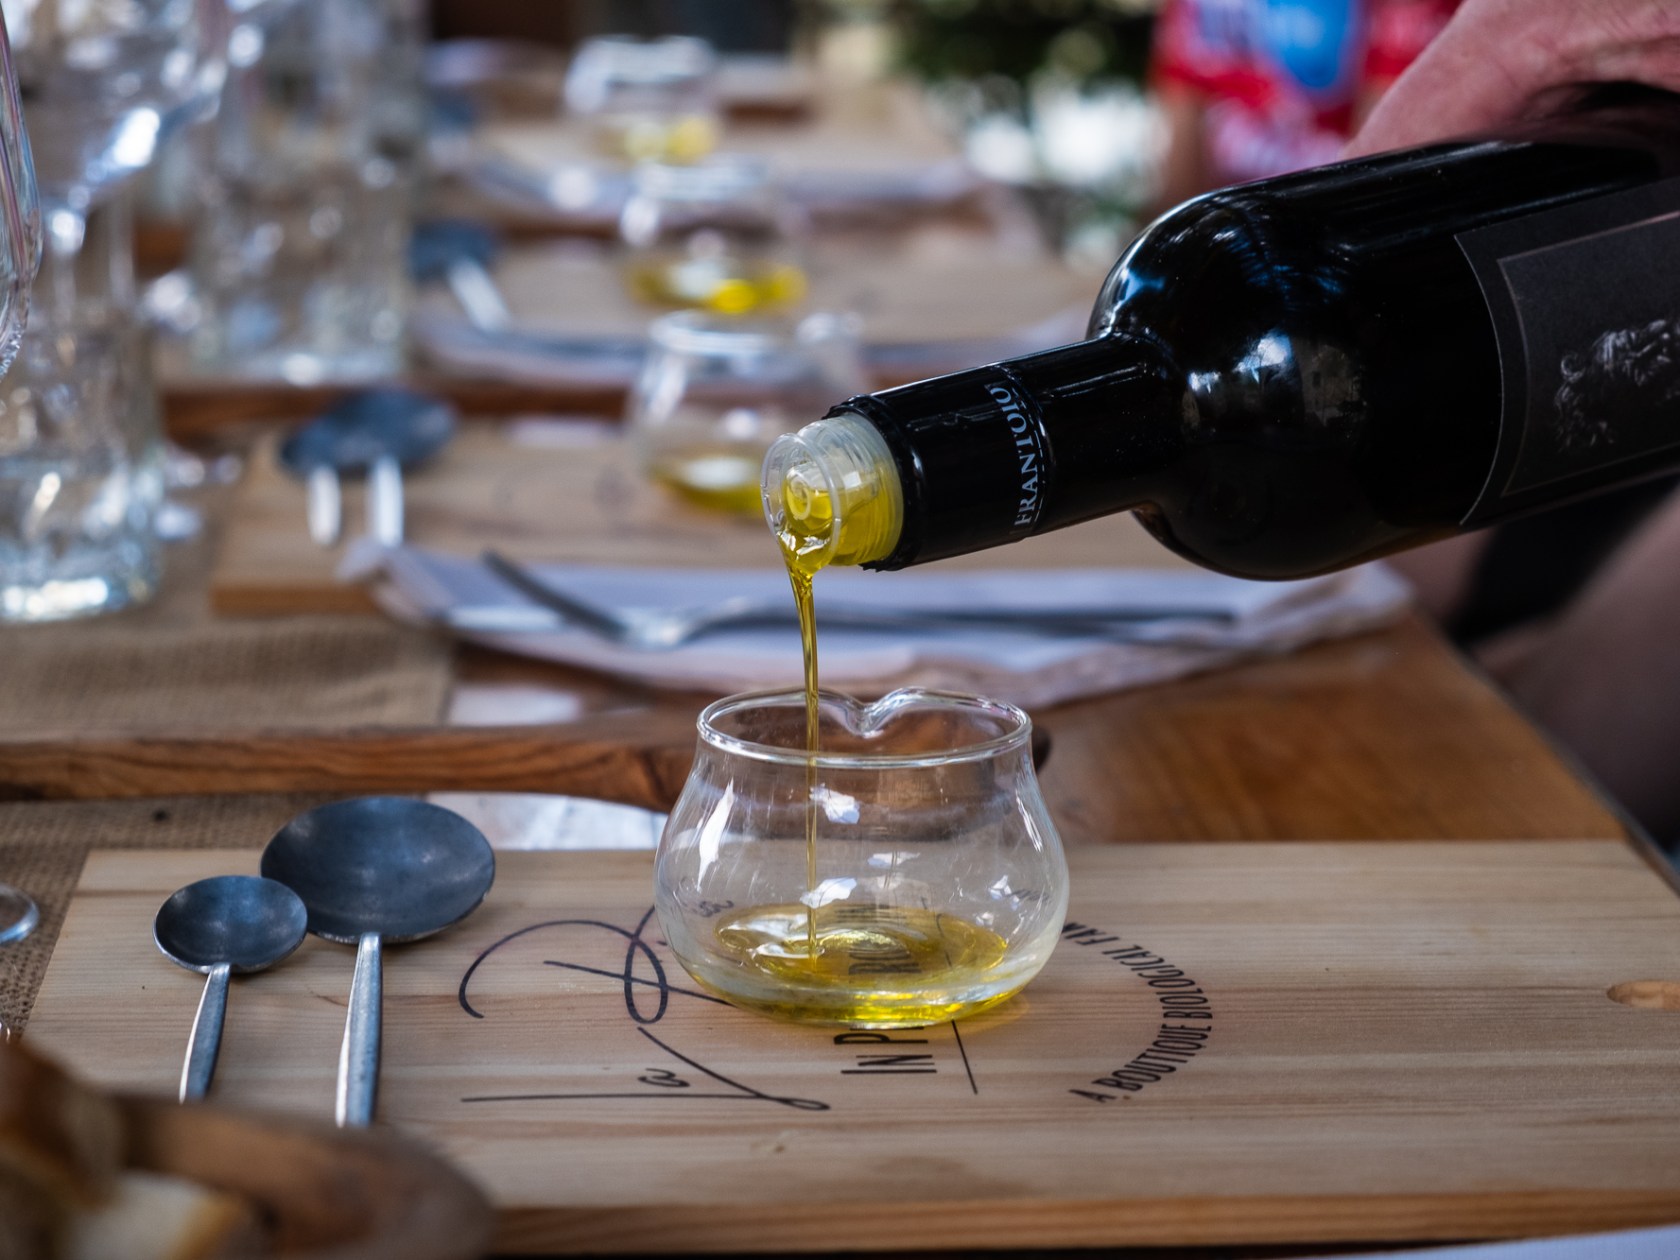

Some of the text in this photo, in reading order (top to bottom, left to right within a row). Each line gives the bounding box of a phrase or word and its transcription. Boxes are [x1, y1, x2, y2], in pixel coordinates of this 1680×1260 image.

[990, 387, 1038, 525] FRANTOIO
[1102, 944, 1213, 1019] BIOLOGICAL
[1091, 1023, 1212, 1092] BOUTIQUE
[1068, 1089, 1117, 1104] A
